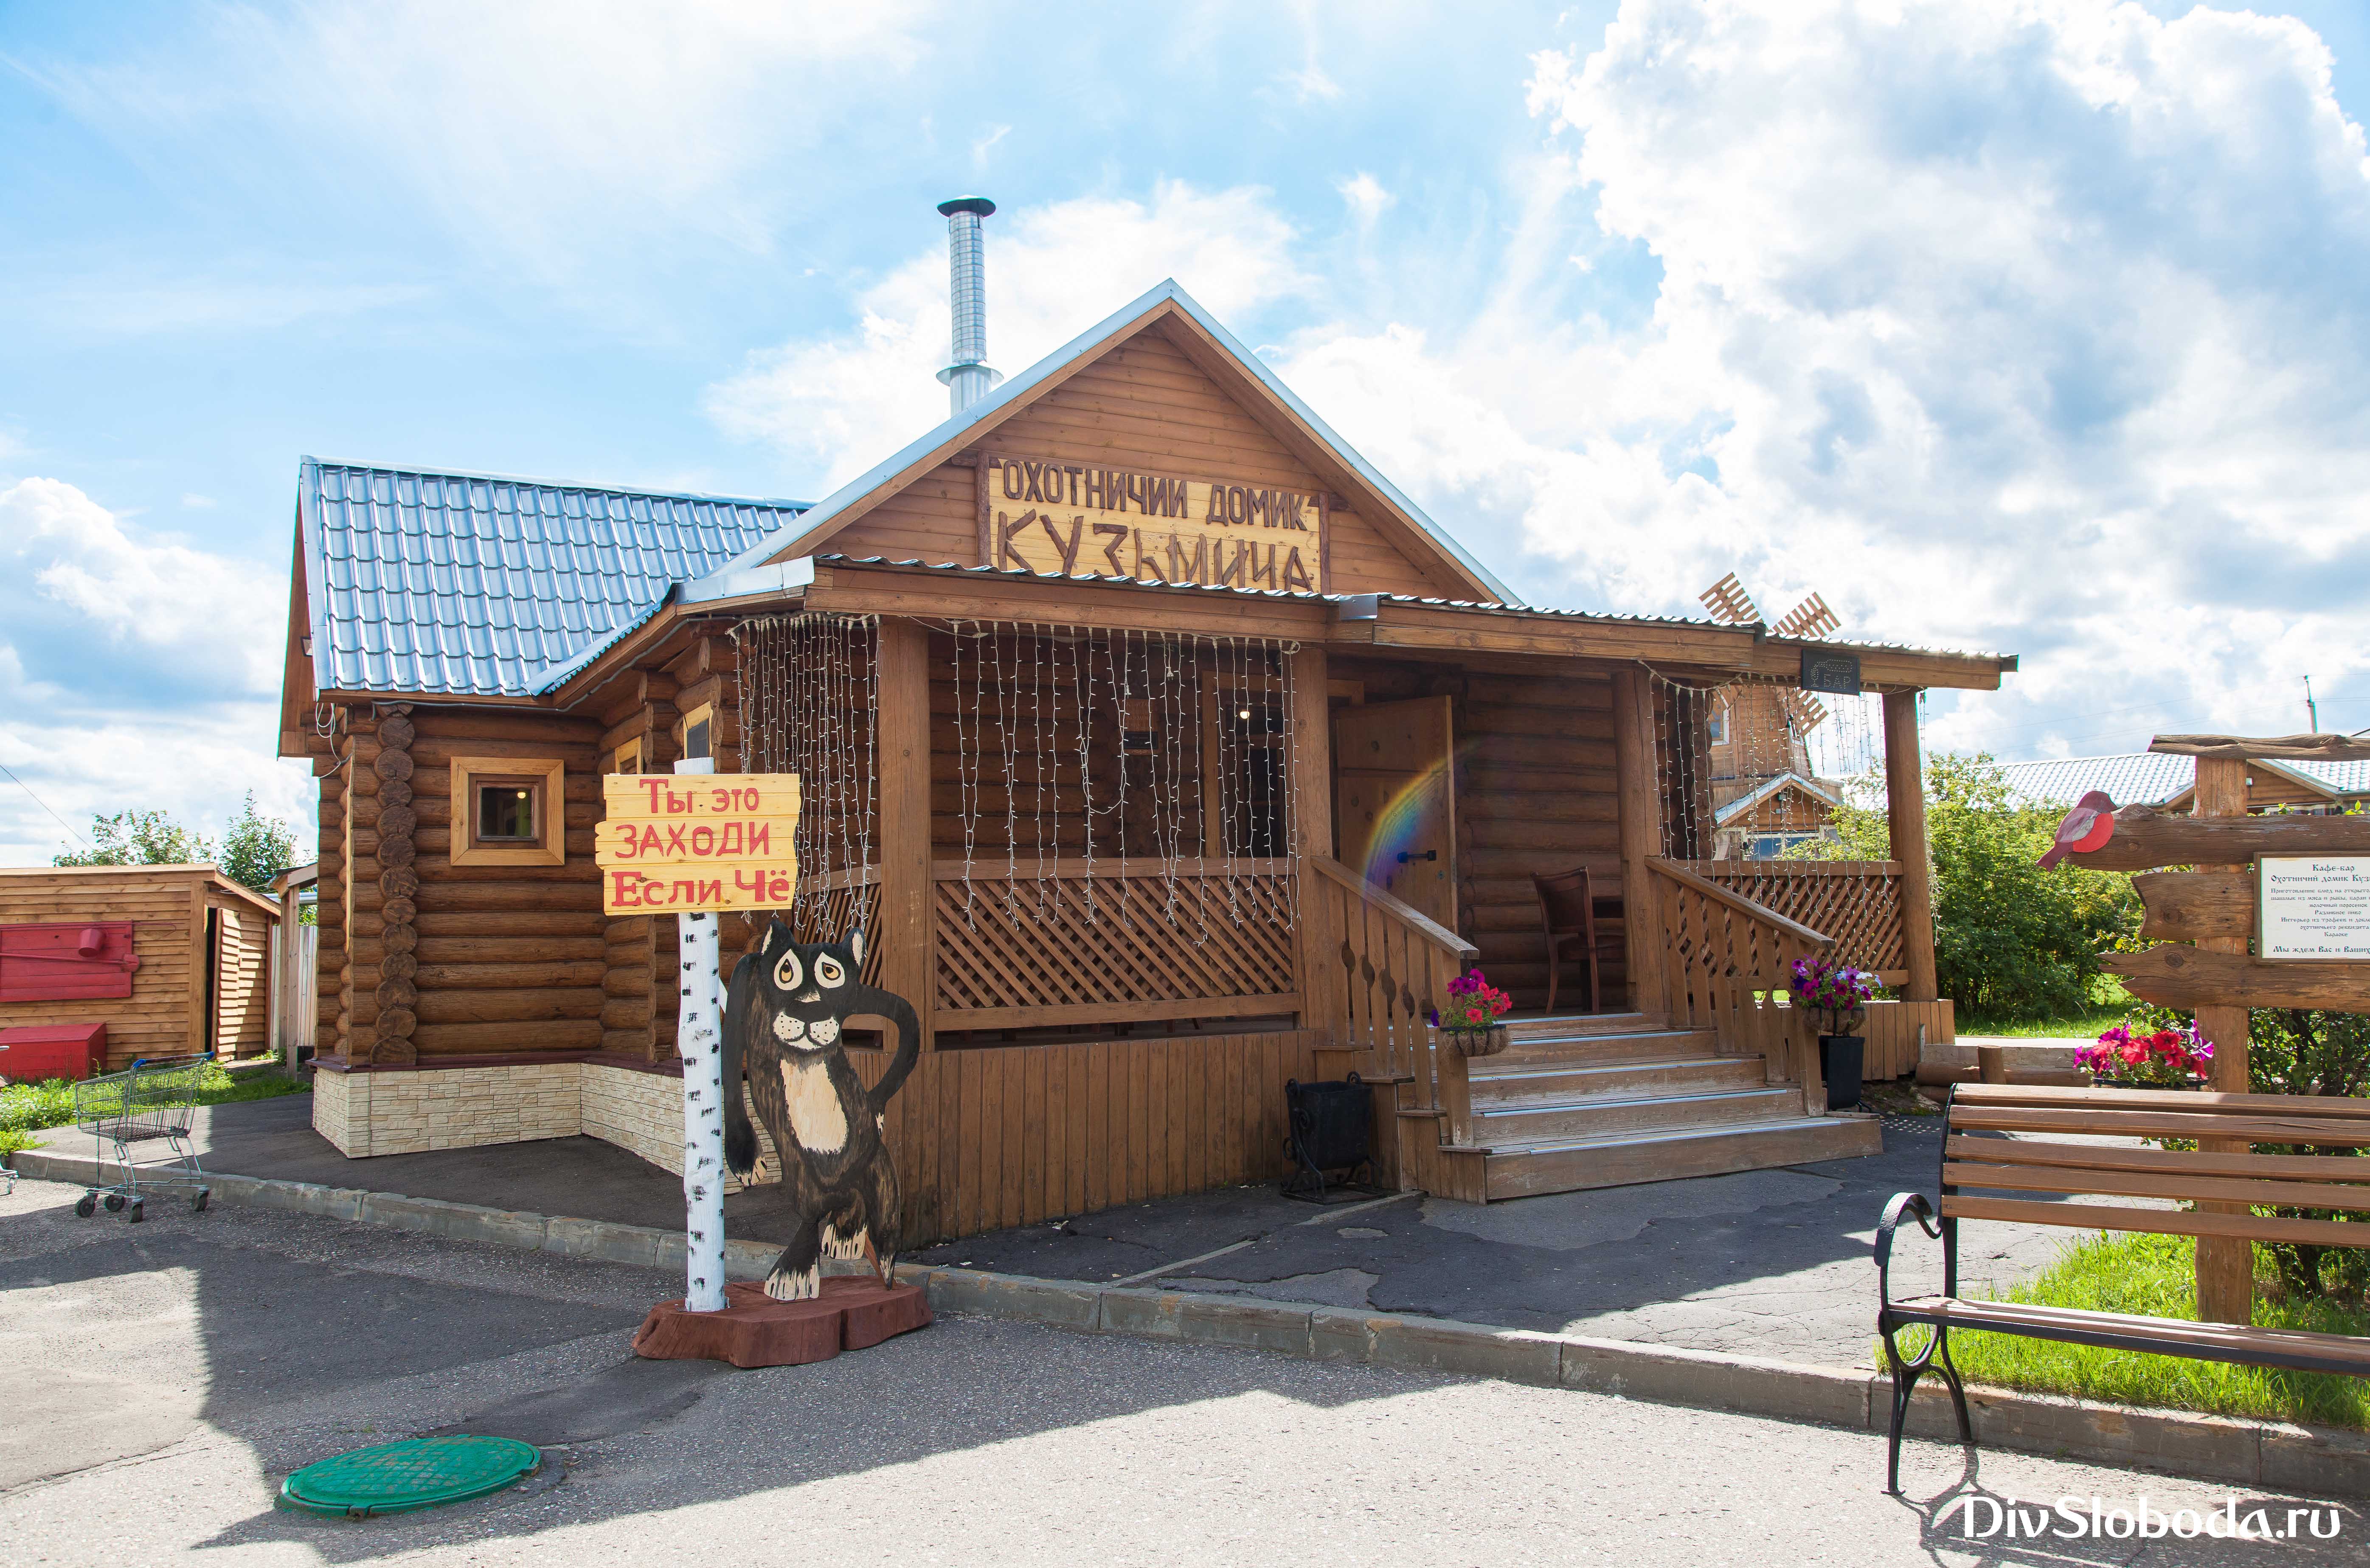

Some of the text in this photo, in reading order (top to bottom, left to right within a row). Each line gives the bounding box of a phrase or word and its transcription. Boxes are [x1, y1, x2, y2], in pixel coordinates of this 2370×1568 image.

[1206, 484, 1307, 531] ДОМИК
[1824, 674, 1851, 689] БАР
[639, 778, 759, 813] Ты это
[616, 822, 769, 858] ЗАХОДИ
[2271, 875, 2318, 884] Охотничий
[2352, 874, 2370, 884] Куз
[2312, 864, 2355, 873] Кафе-бар
[611, 870, 789, 906] Если Чё
